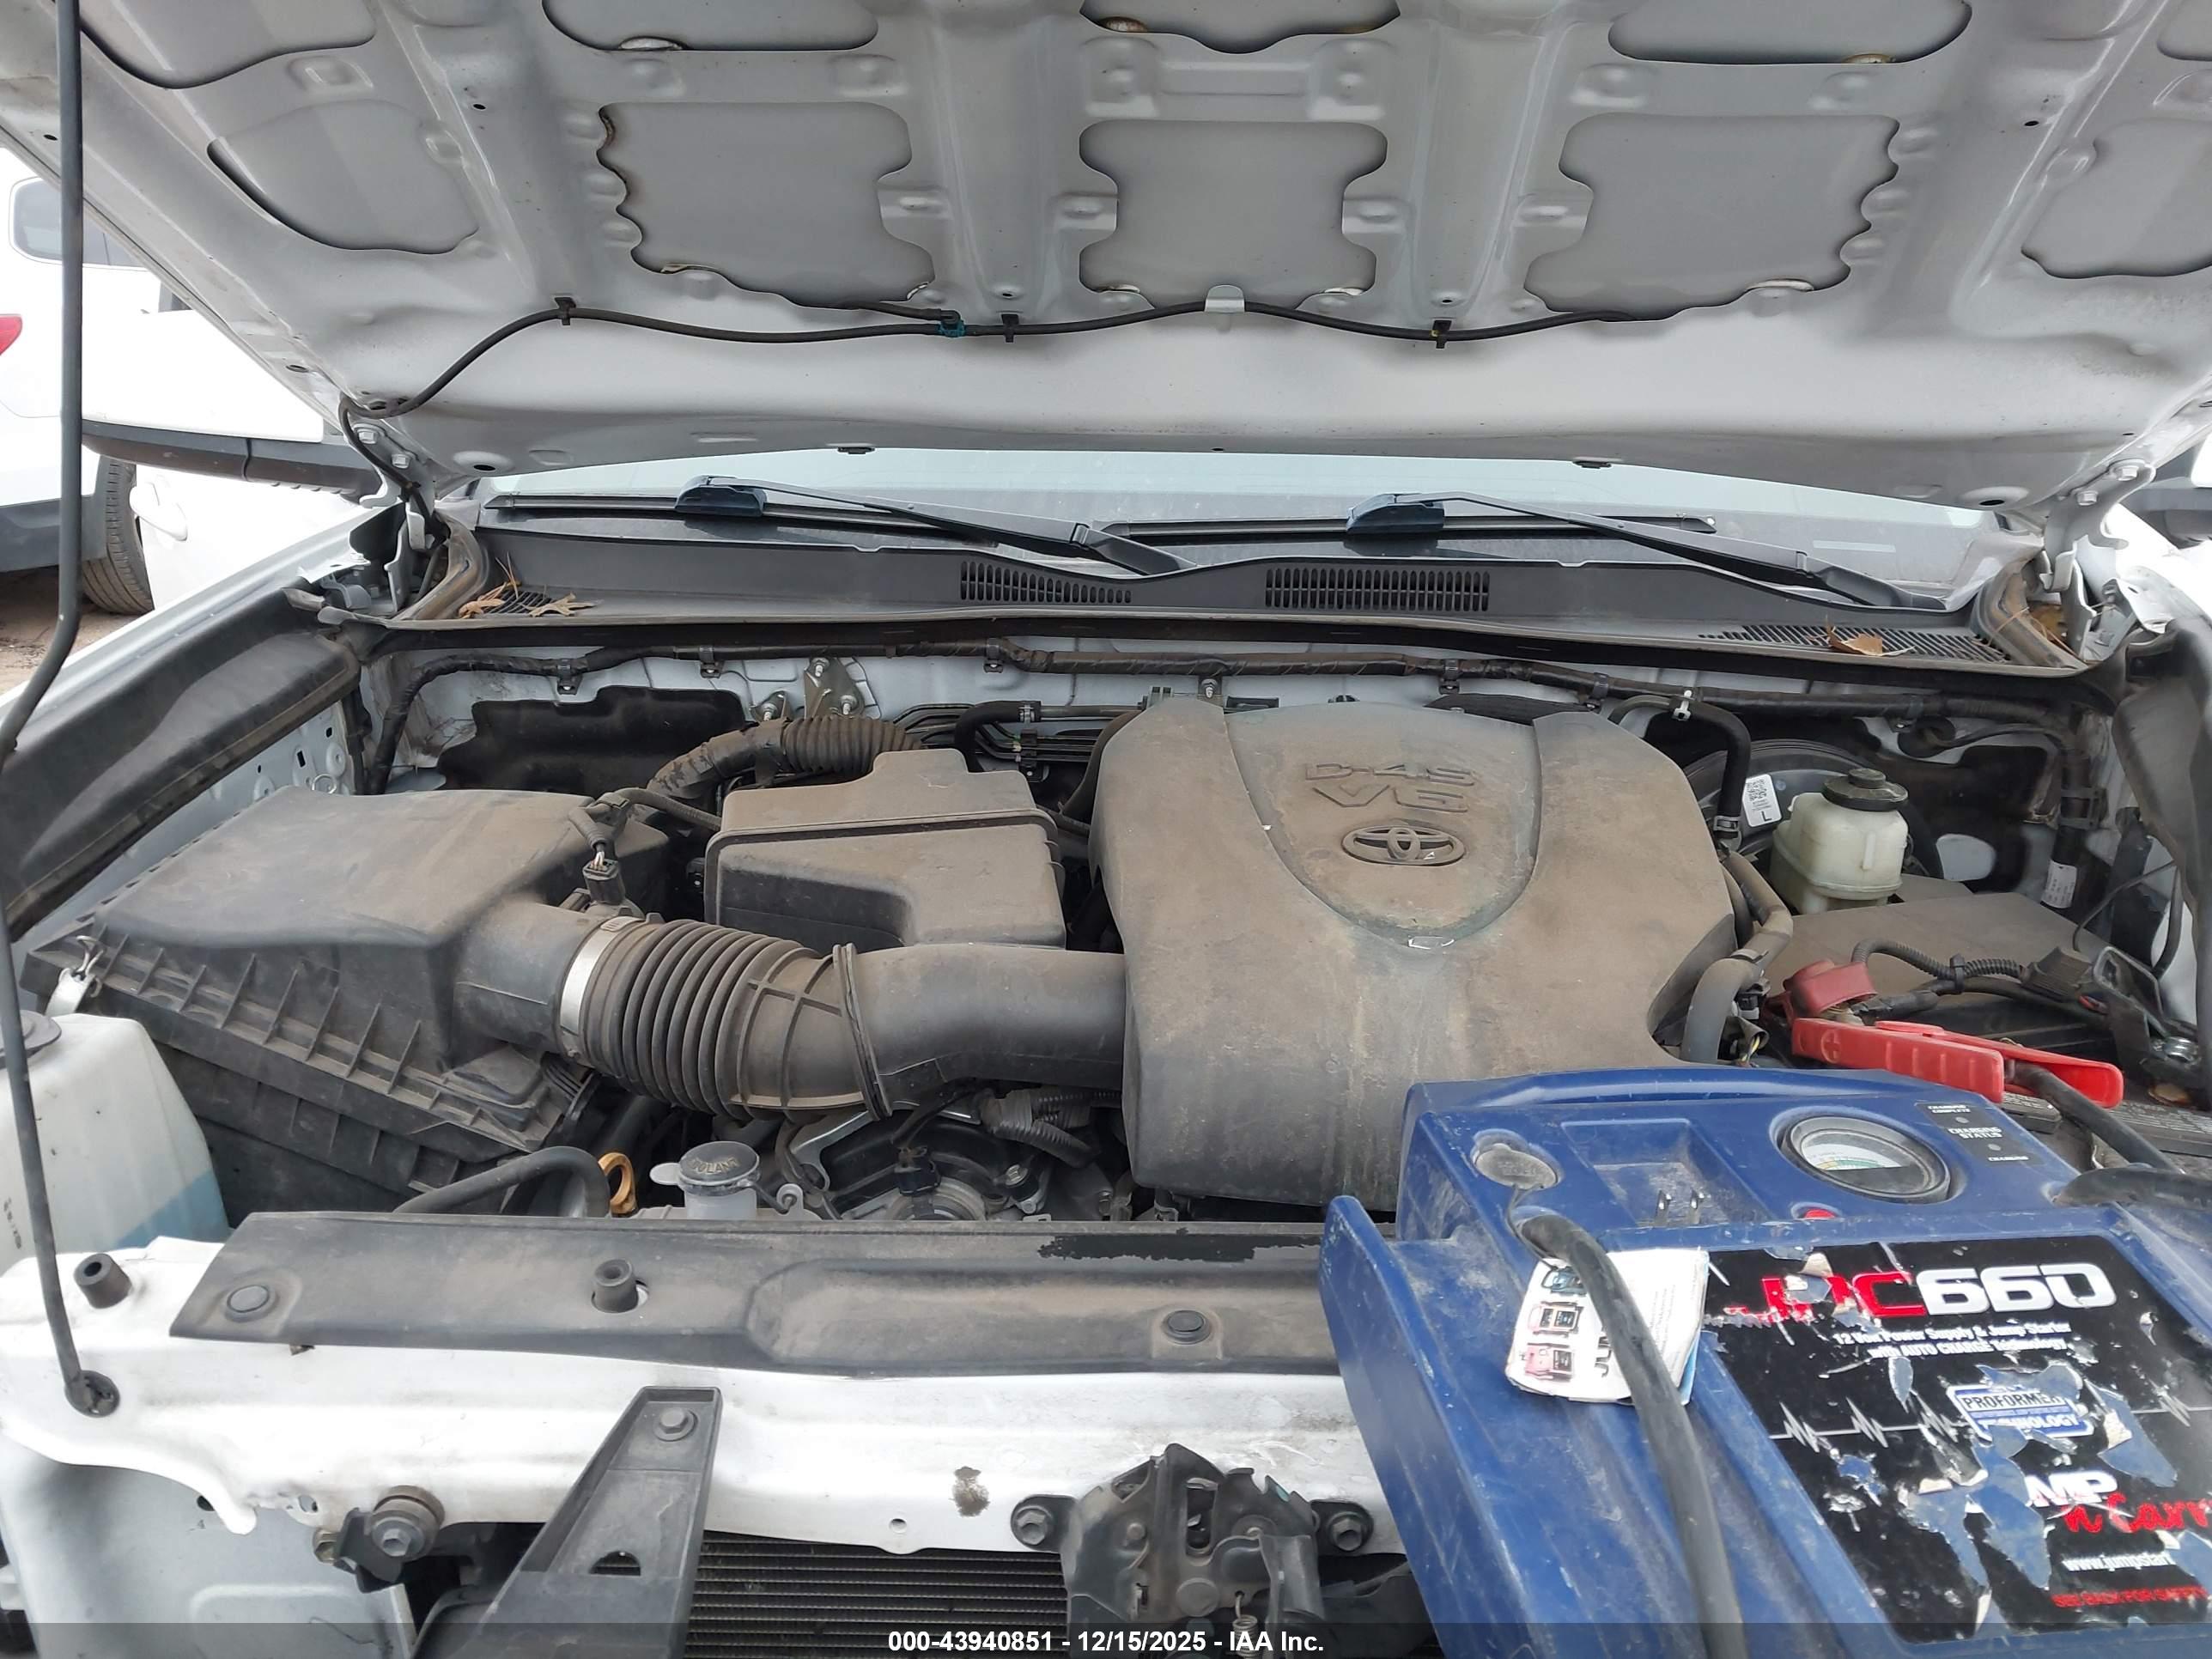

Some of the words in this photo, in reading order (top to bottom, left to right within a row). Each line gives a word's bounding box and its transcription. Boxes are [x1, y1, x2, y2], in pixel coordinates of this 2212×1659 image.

[1311, 784, 1469, 812] V6
[1832, 1333, 1855, 1345] 12
[1881, 1329, 1925, 1342] Power
[1925, 1327, 1974, 1340] Supply
[1987, 1324, 2027, 1338] Jump
[2024, 1322, 2072, 1334] Starter
[1900, 1343, 1939, 1357] AUTO
[1936, 1339, 1995, 1354] CHARGE
